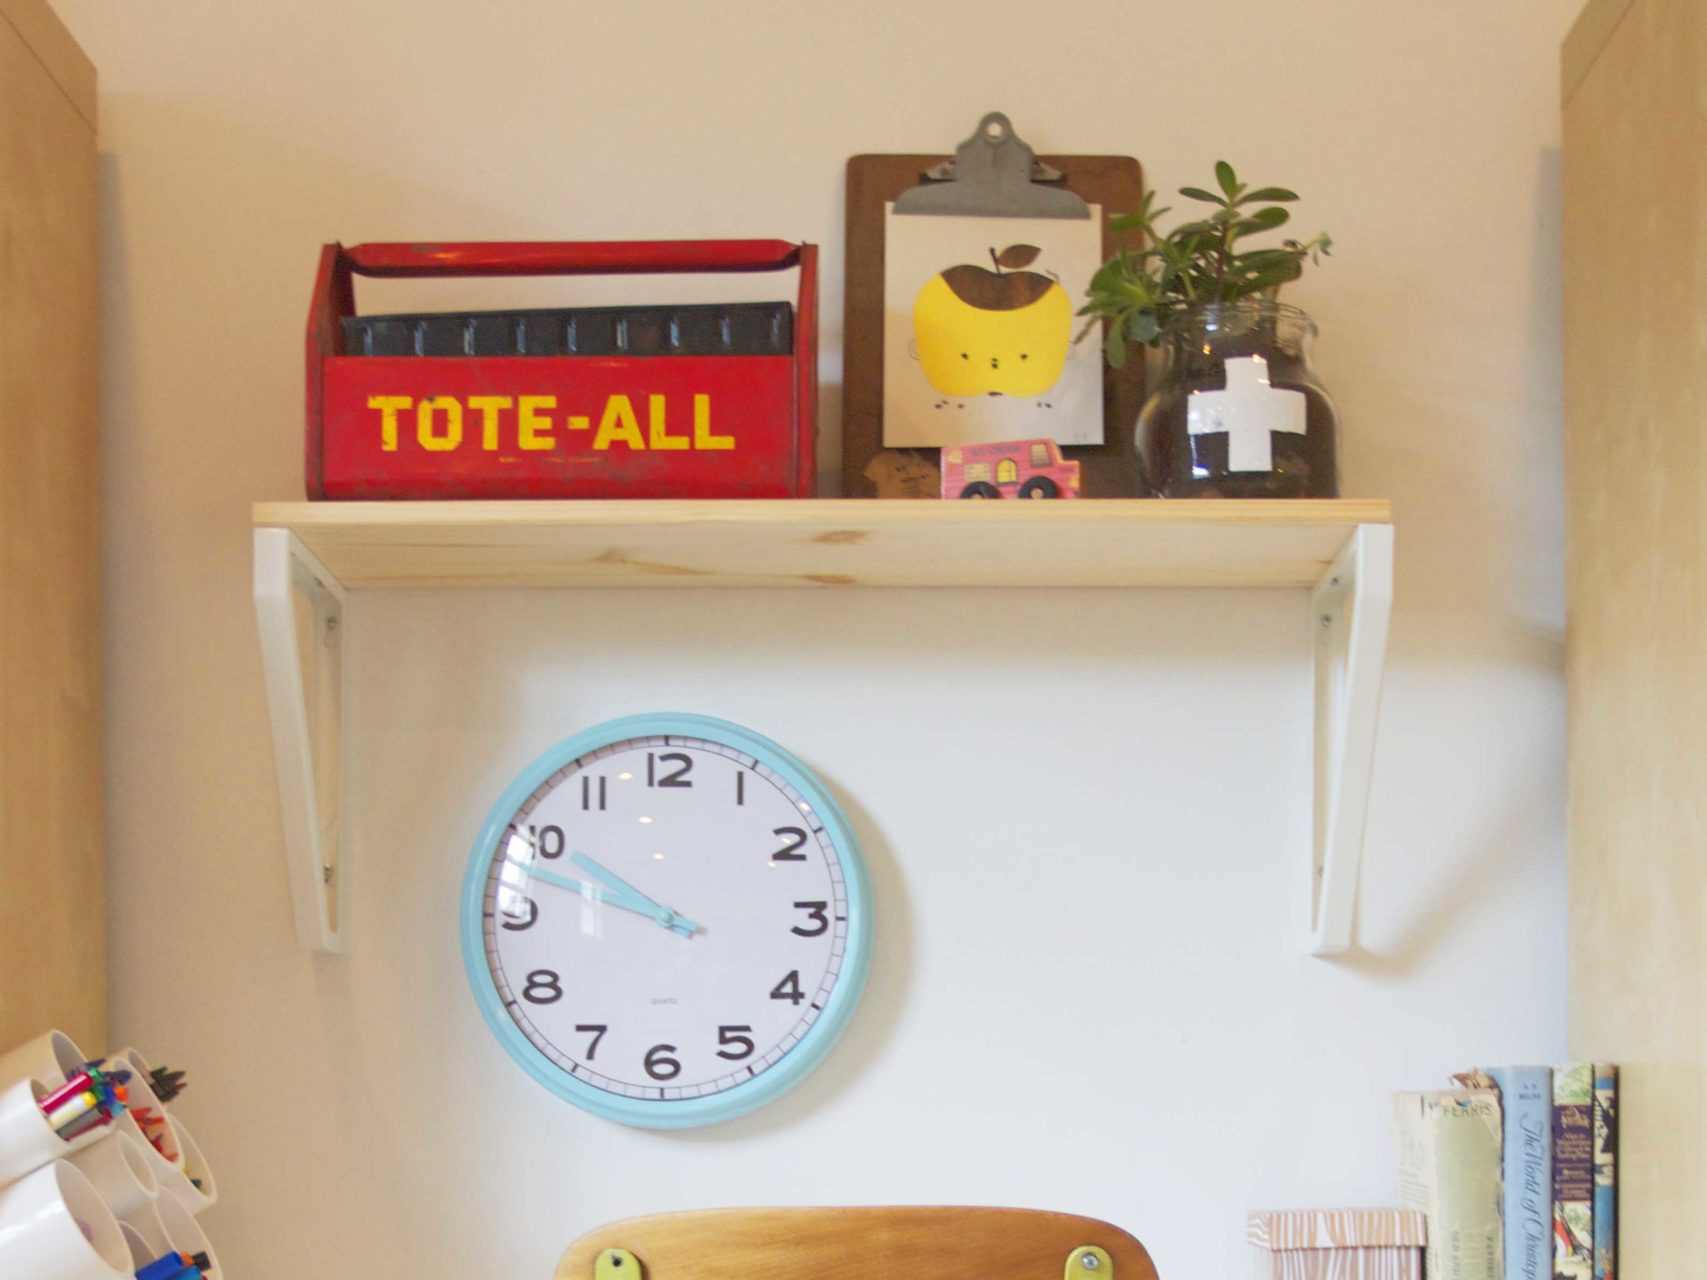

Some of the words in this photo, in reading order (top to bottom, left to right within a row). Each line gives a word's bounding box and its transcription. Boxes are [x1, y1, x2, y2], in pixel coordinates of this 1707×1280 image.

[368, 394, 735, 451] TOTE-ALL
[647, 753, 693, 788] 12
[736, 771, 745, 805] 1
[582, 776, 607, 810] 11
[771, 826, 807, 861] 2
[790, 901, 829, 937] 3
[522, 969, 563, 1004] 8
[770, 970, 805, 1006] 4
[575, 1025, 607, 1060] 7
[715, 1025, 755, 1060] 5
[643, 1044, 681, 1081] 6
[1519, 1113, 1544, 1151] The
[1524, 1144, 1545, 1196] World
[1520, 1197, 1541, 1218] of
